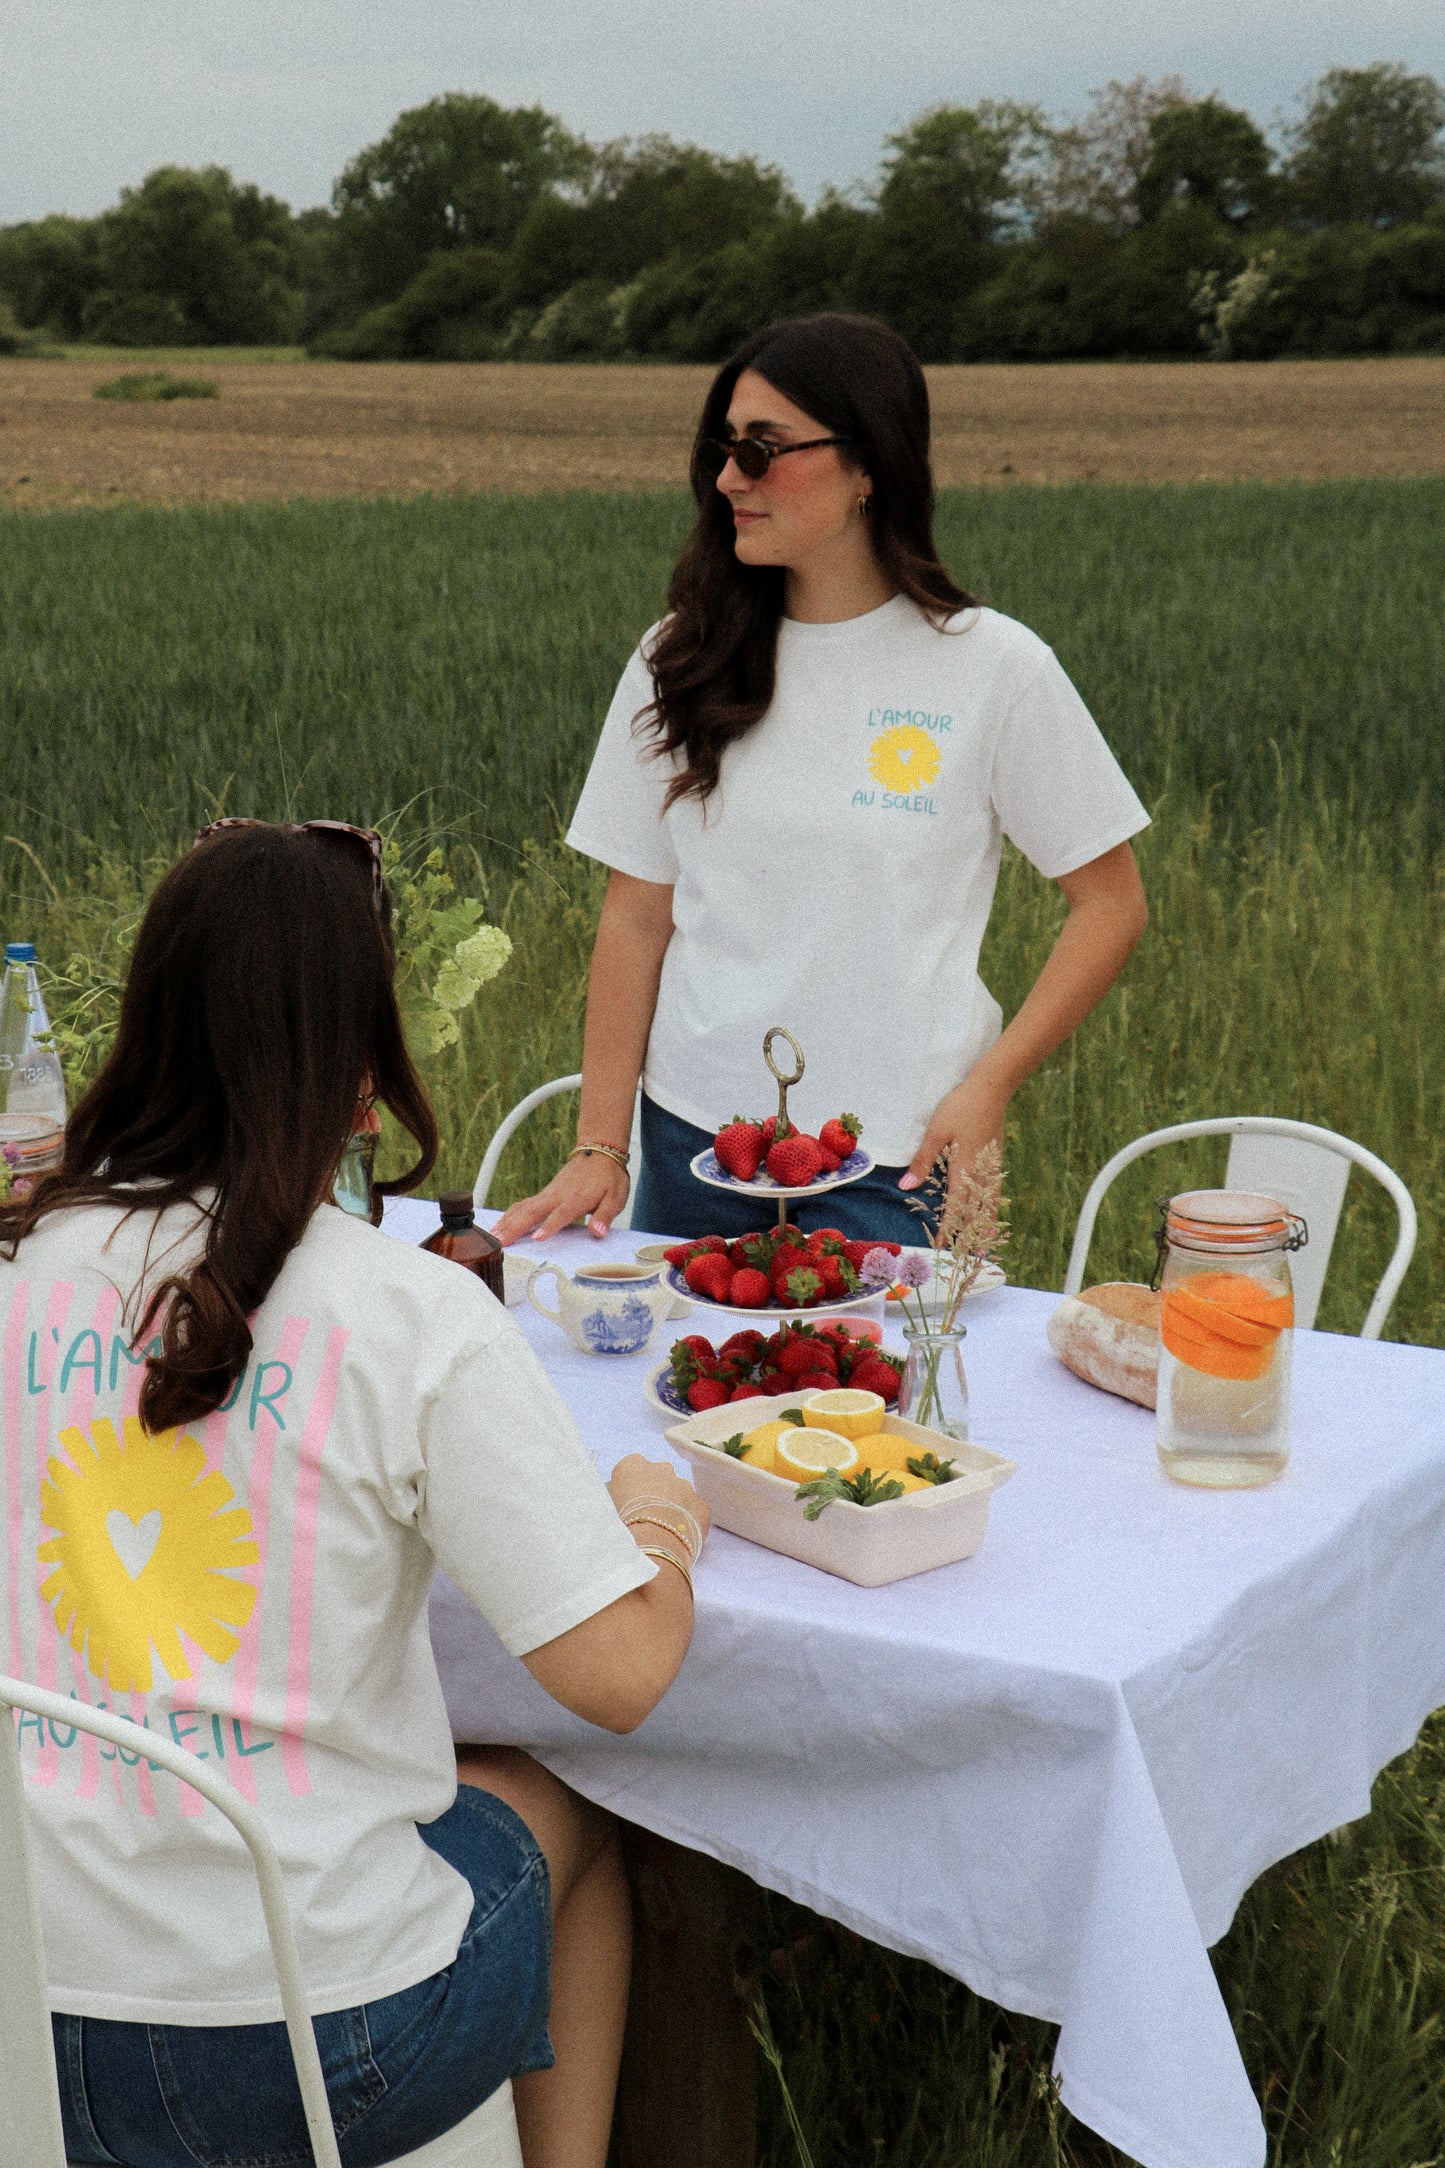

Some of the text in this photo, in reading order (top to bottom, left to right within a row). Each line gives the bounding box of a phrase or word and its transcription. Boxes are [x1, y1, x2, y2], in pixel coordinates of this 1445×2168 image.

[868, 708, 952, 732] L'AMOUR
[852, 790, 938, 815] AU SOLEIL
[28, 1328, 293, 1431] L'AMR
[17, 1690, 275, 1771] AU OEIL
